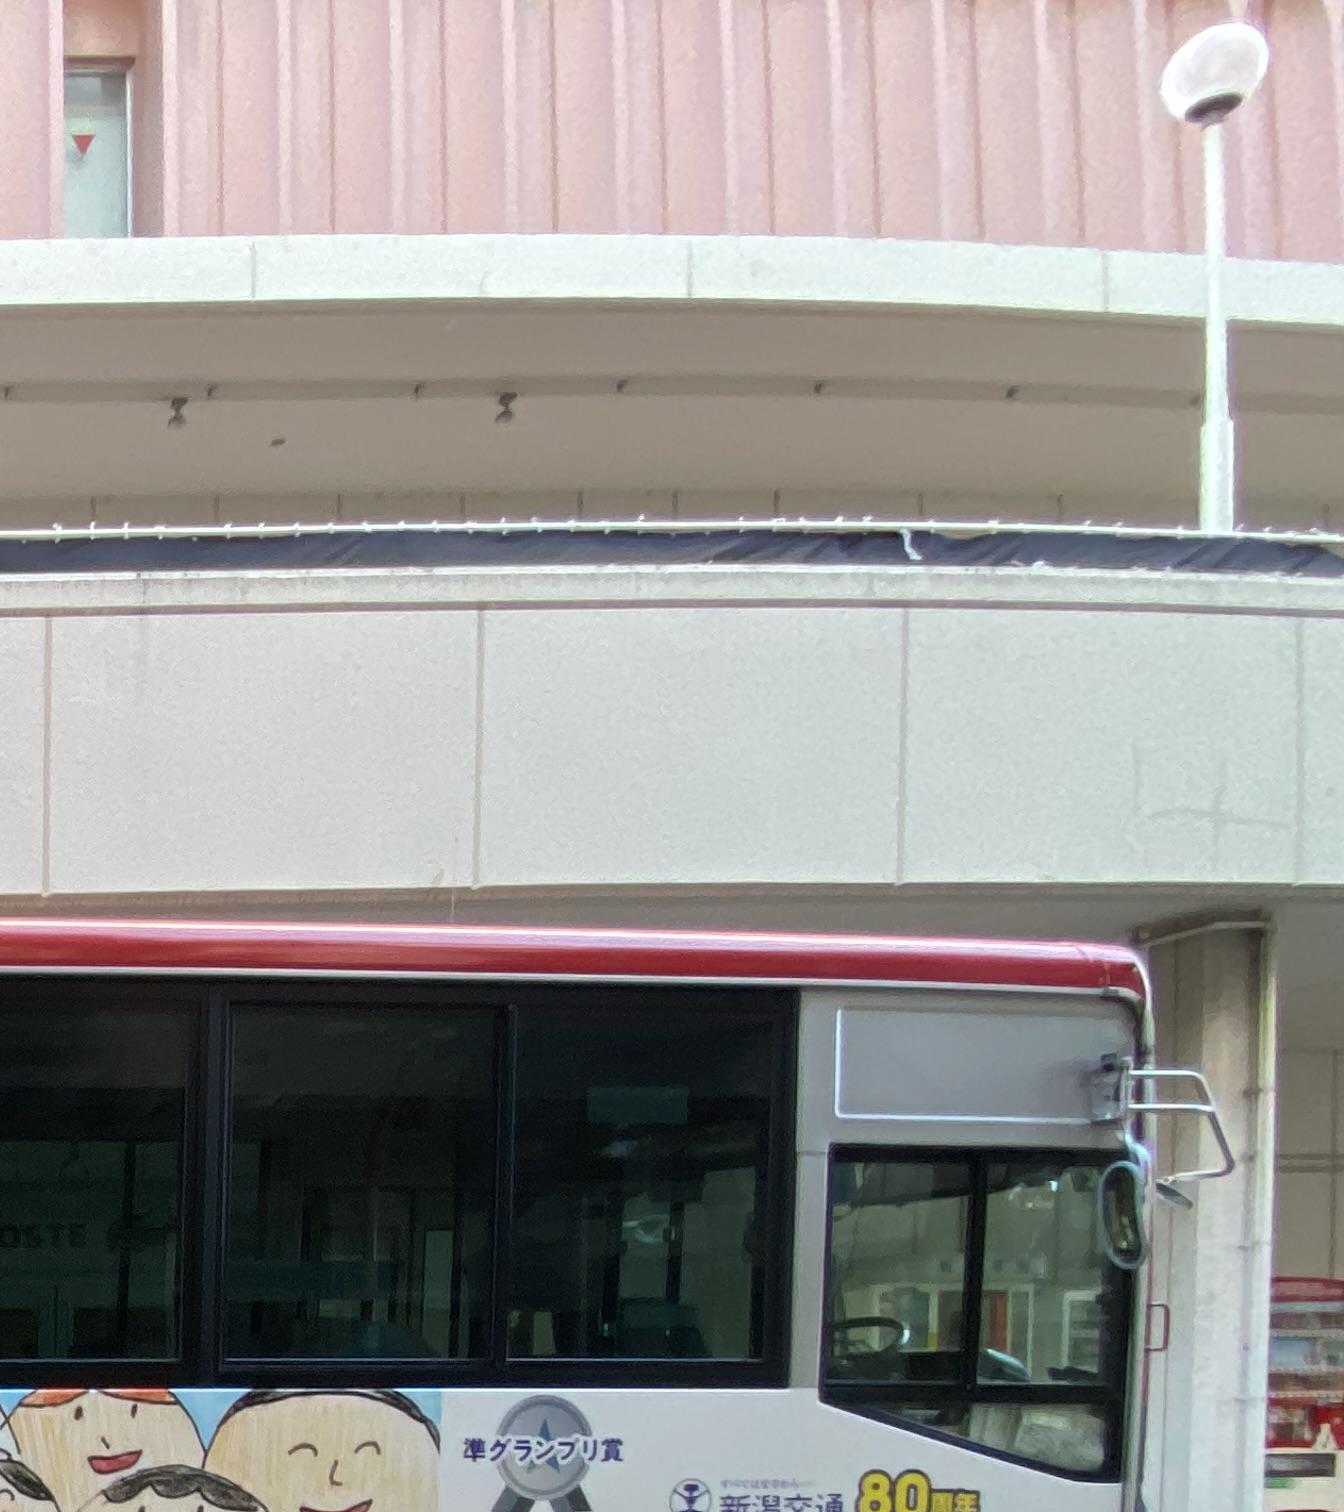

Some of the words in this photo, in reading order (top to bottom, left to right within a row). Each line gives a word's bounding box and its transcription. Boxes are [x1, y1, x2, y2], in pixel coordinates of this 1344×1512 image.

[463, 1437, 624, 1462] 準グランプリ賞
